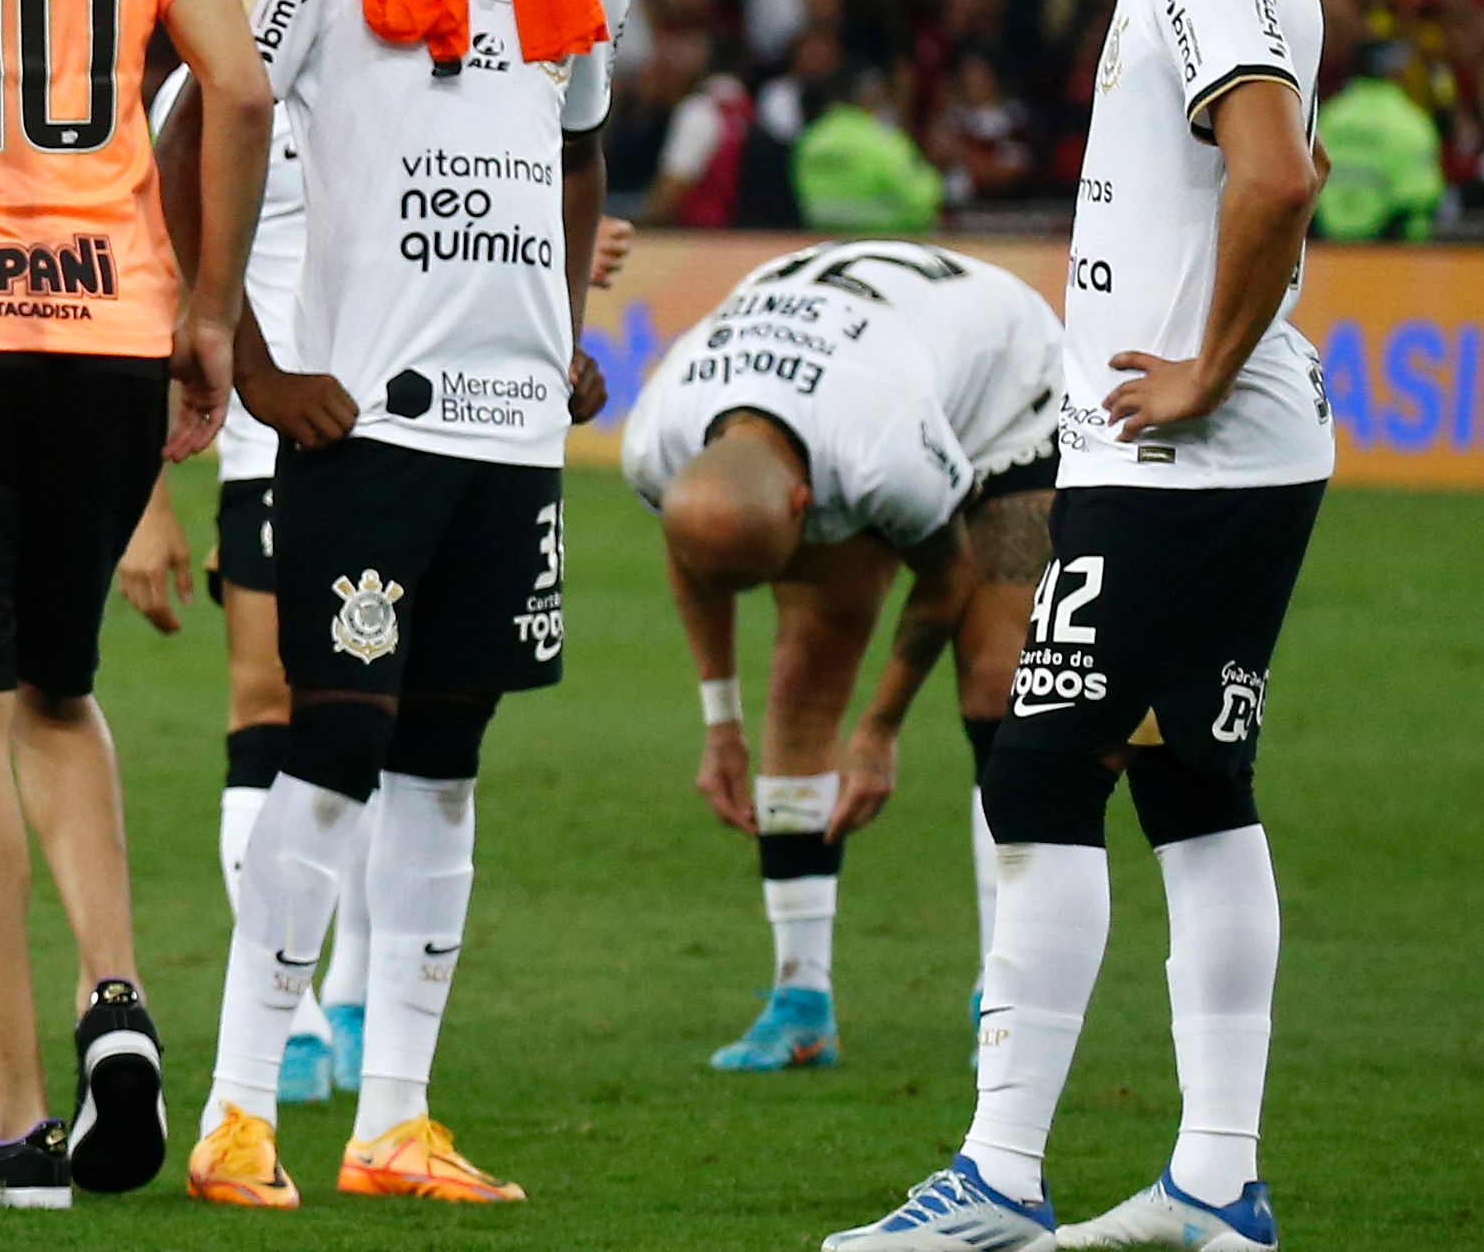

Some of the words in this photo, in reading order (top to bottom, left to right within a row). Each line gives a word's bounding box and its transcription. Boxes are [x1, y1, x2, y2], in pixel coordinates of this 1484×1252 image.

[467, 58, 511, 72] ALE
[401, 150, 553, 186] vitaminas
[400, 188, 491, 219] neo
[400, 222, 552, 273] química
[441, 371, 548, 401] Mercado
[441, 399, 525, 427] Bitcoin
[1030, 555, 1105, 644] 42
[513, 610, 564, 642] TOD
[1070, 650, 1095, 668] de
